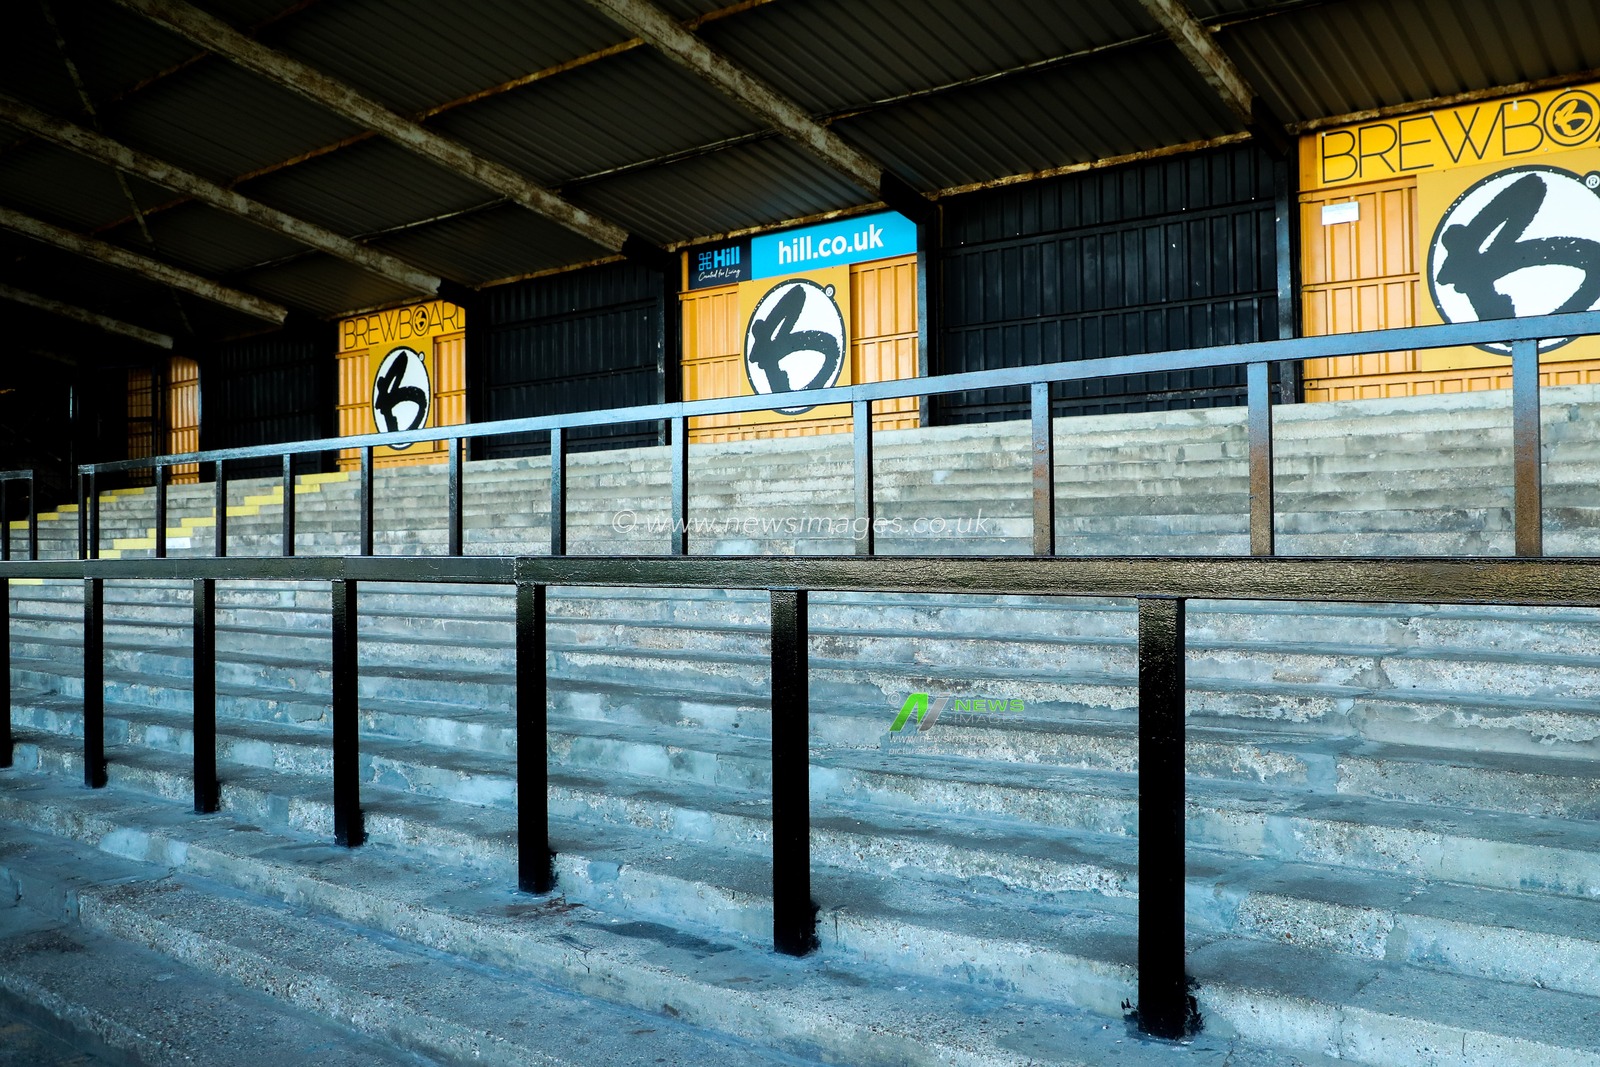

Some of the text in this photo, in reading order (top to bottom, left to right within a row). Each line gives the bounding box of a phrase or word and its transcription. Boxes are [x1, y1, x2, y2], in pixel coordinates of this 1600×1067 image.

[1321, 89, 1600, 184] BREWBO
[714, 246, 740, 268] Hill
[778, 224, 884, 265] hill.co.uk
